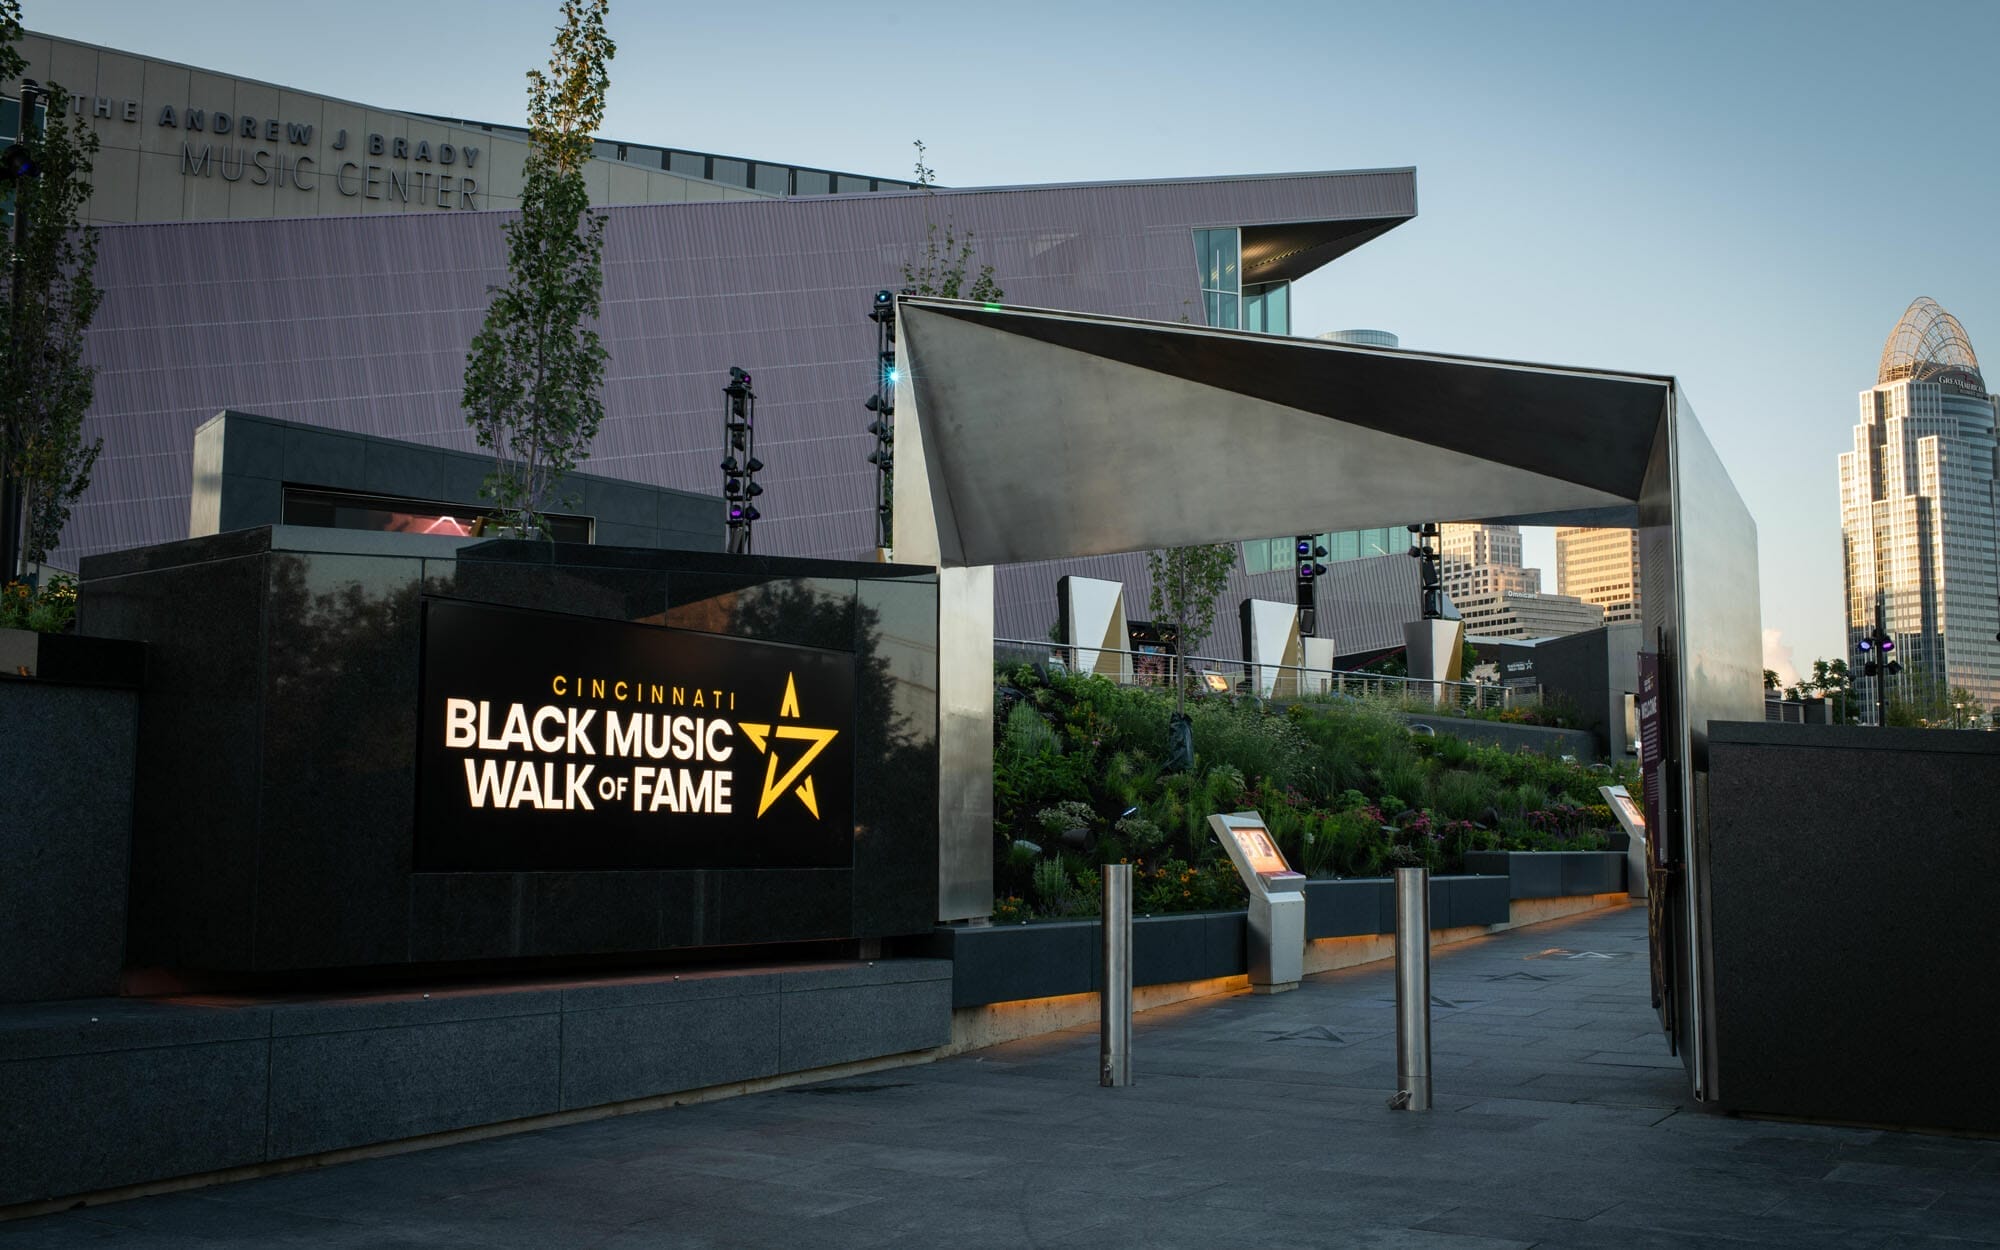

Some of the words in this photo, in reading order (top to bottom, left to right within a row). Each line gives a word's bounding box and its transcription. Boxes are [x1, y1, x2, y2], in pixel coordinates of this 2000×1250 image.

[71, 93, 137, 122] THE
[158, 104, 313, 146] ANDREW
[332, 128, 347, 151] J
[368, 133, 481, 169] BRADY
[181, 141, 315, 192] MUSIC
[336, 161, 479, 212] CENTER
[552, 674, 736, 711] CINCINNATI
[1641, 696, 1657, 720] WELCOME
[445, 697, 598, 756] BLACK
[605, 710, 734, 763] MUSIC
[463, 757, 596, 812] WALK
[598, 776, 629, 801] OF
[633, 766, 733, 814] FAME
